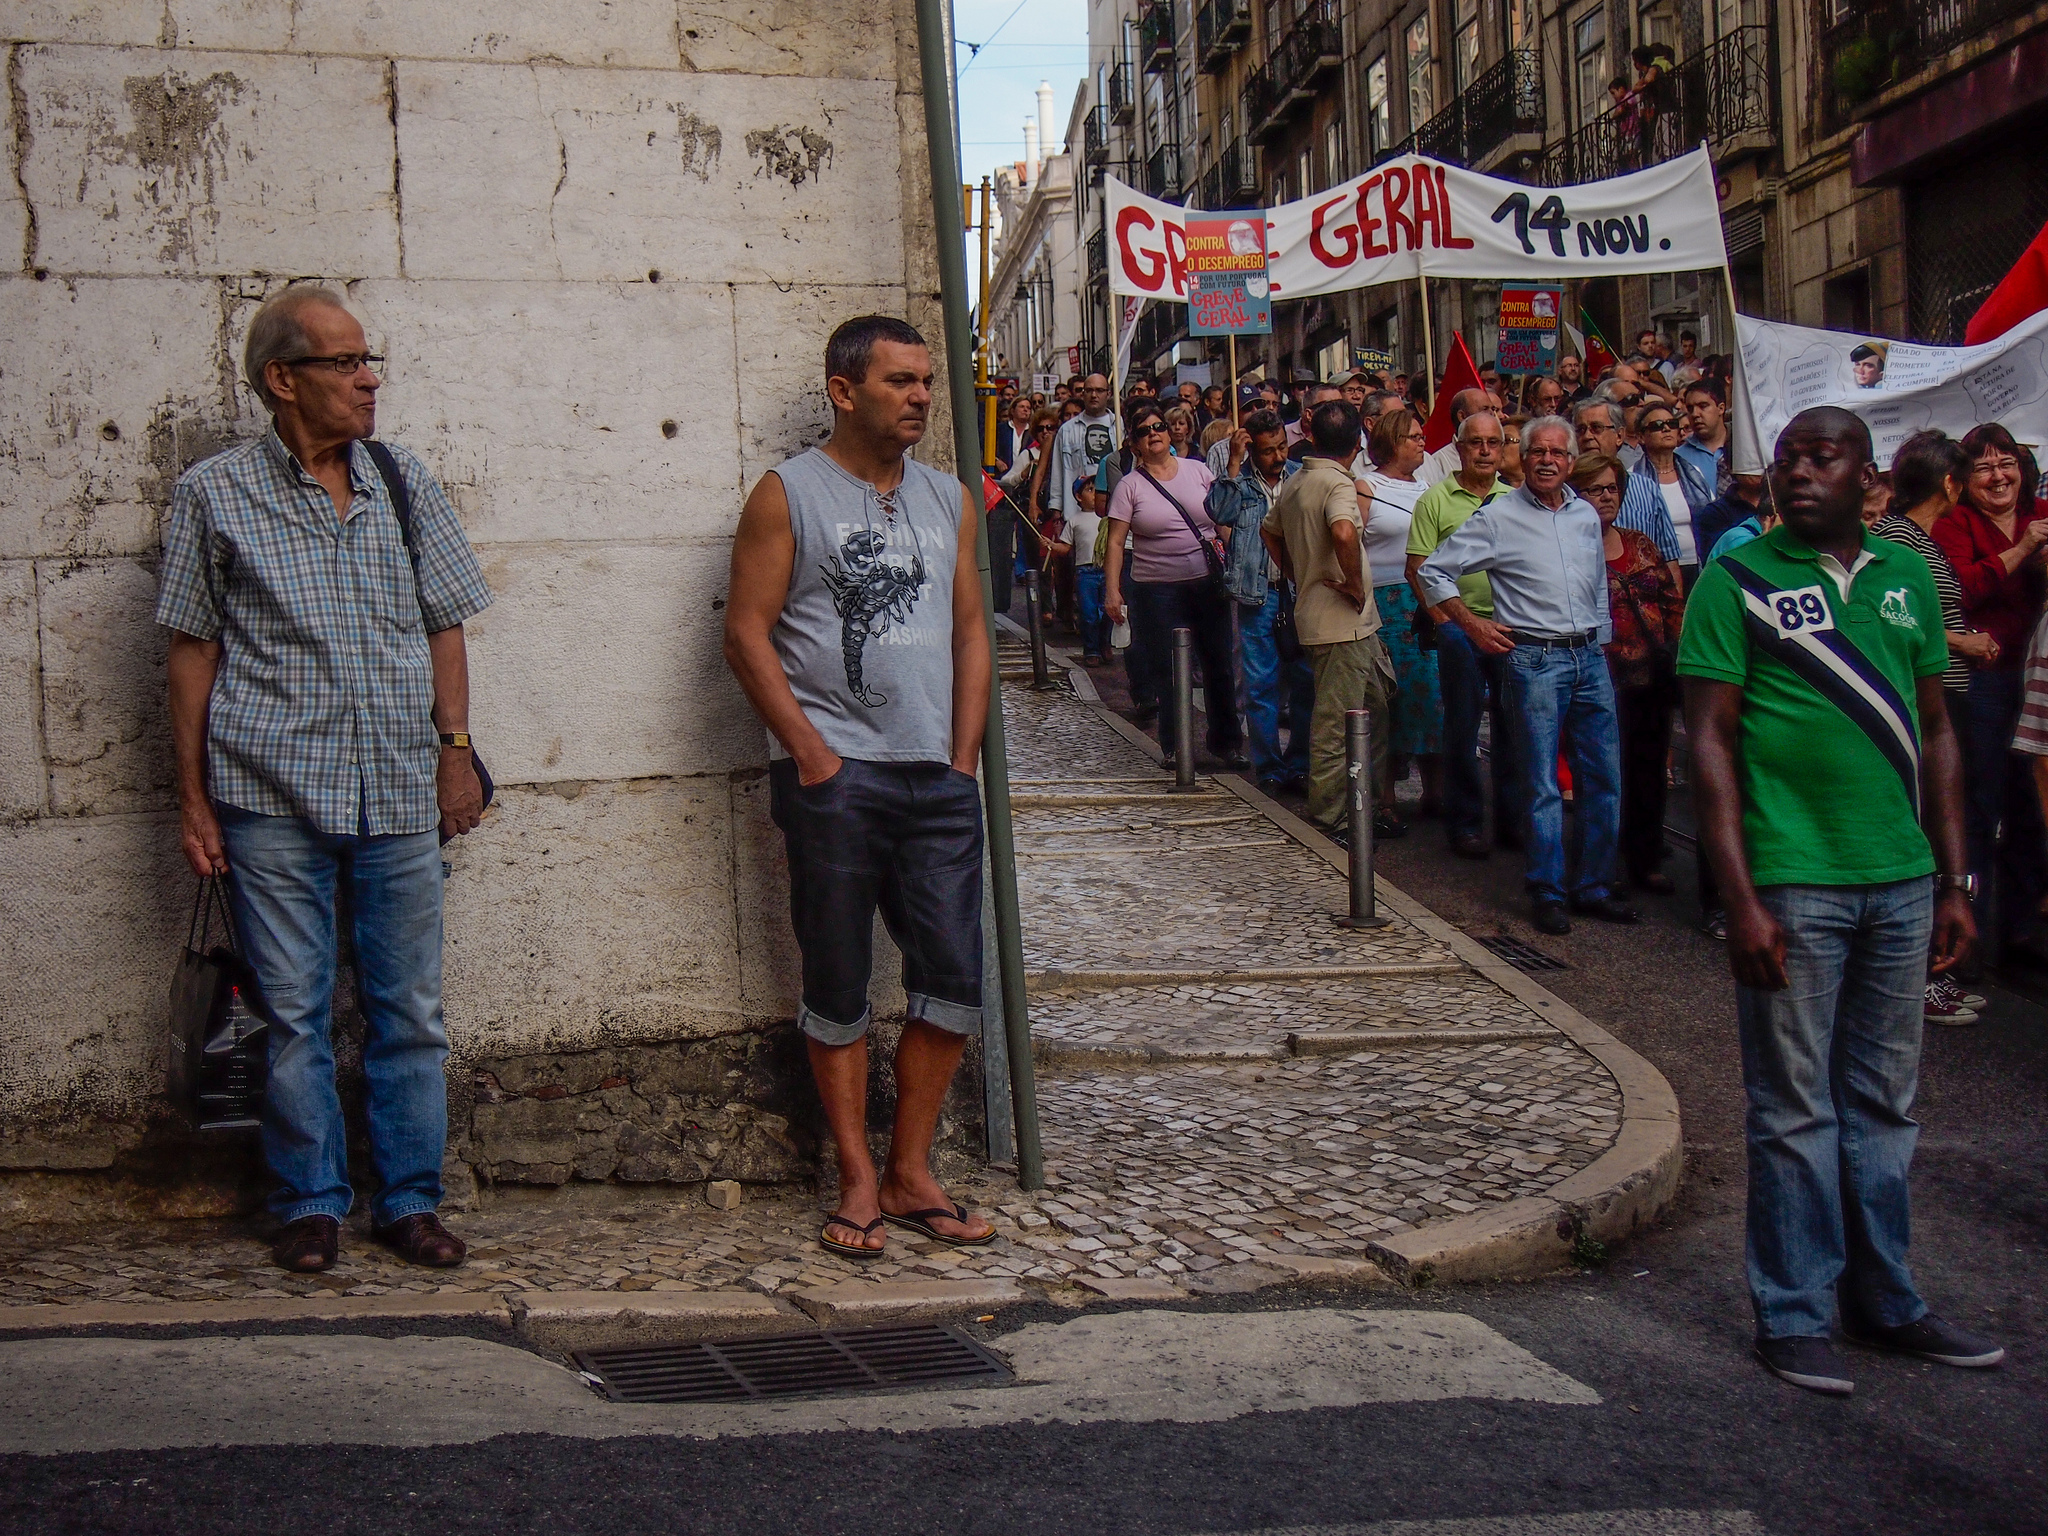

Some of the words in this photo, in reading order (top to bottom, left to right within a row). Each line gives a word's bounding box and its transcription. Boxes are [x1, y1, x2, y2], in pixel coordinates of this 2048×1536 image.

[1310, 164, 1474, 269] GERAL
[1491, 192, 1571, 257] 14
[1187, 236, 1225, 251] CONTRA
[1188, 257, 1195, 271] O
[1199, 254, 1265, 271] DESEMPREGO
[1189, 275, 1198, 284] 14
[1200, 274, 1213, 282] POR
[1229, 272, 1267, 281] PORTUGAL
[1199, 282, 1215, 290] COM
[1191, 287, 1247, 310] GREVE
[1501, 302, 1529, 313] CONTRA
[1196, 306, 1250, 328] GERAL
[1500, 316, 1505, 327] O
[1508, 317, 1556, 328] DESEMPREGO
[1499, 340, 1539, 357] GREVE
[1890, 346, 1908, 355] NADA
[1501, 354, 1540, 370] GERAL
[1992, 364, 2003, 374] NA
[1979, 373, 2005, 392] ALTURA
[2006, 365, 2016, 376] DE
[1798, 382, 1827, 395] GOVERNO
[1987, 384, 2019, 408] GOVERNO
[1870, 406, 1900, 414] FUTURO
[1991, 406, 2002, 415] NA
[1872, 417, 1901, 427] NOSSOS
[1882, 434, 1906, 443] NETOS
[1775, 593, 1826, 631] 89
